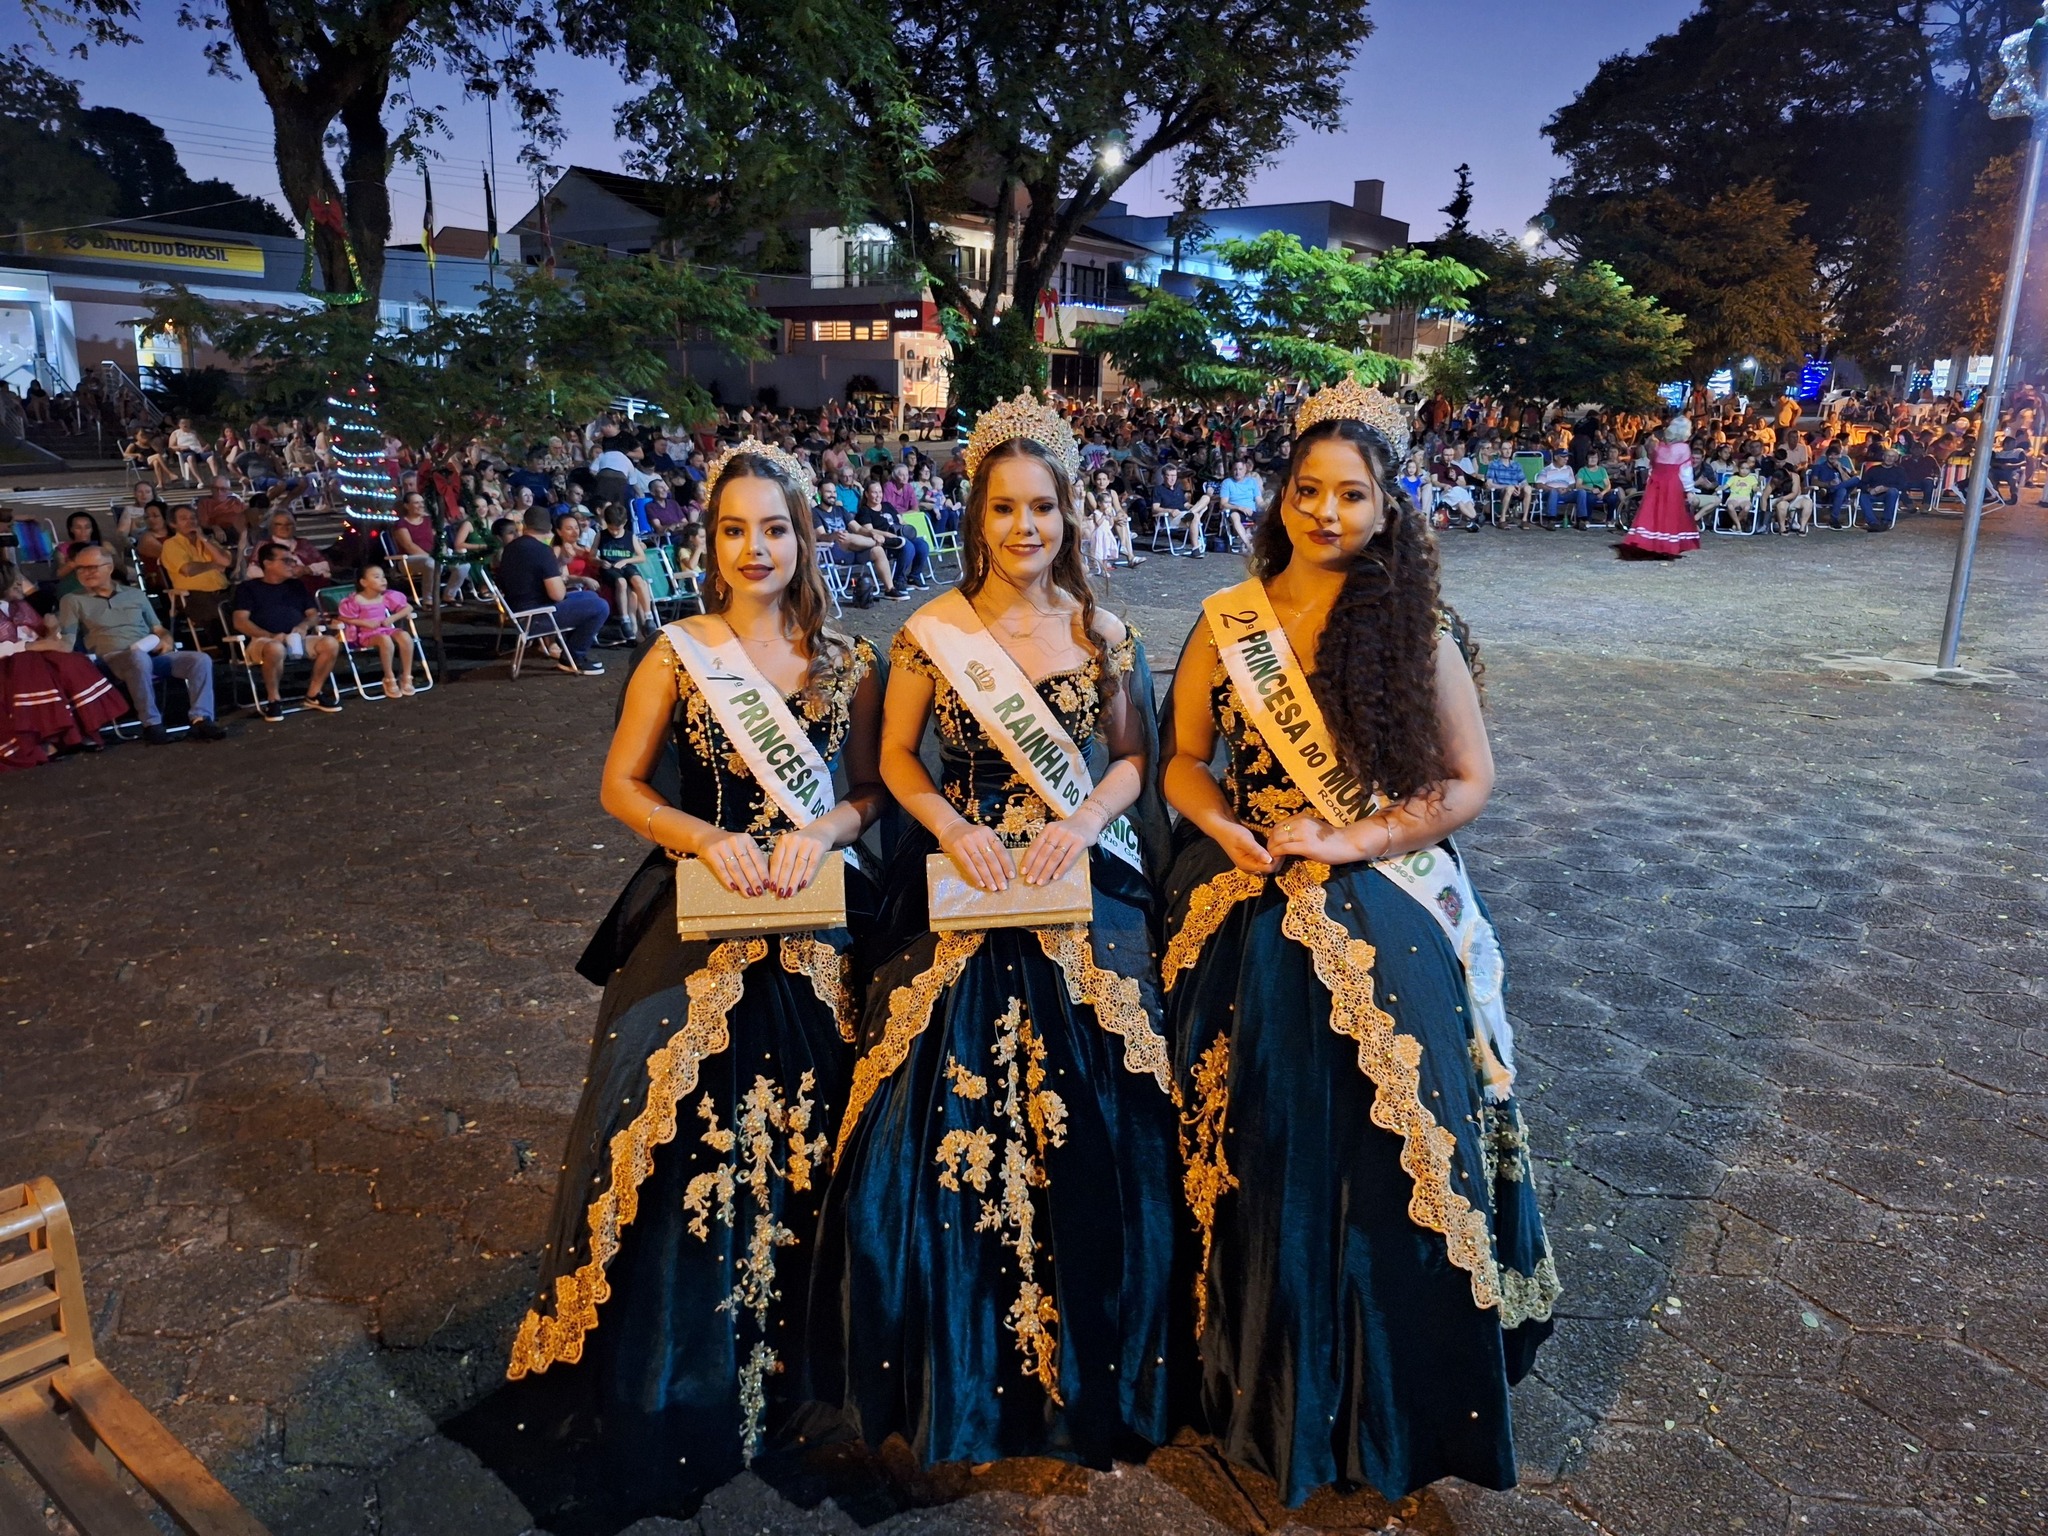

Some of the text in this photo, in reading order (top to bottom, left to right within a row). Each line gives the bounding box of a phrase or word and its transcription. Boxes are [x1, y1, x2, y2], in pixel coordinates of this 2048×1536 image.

[174, 242, 229, 262] BRASIL
[603, 549, 631, 557] TENNIS
[729, 688, 820, 807] PRINCESA
[993, 692, 1070, 790] RAINHA
[1062, 779, 1080, 807] DO
[1237, 629, 1312, 744] PRINCESA
[1298, 741, 1328, 768] DO
